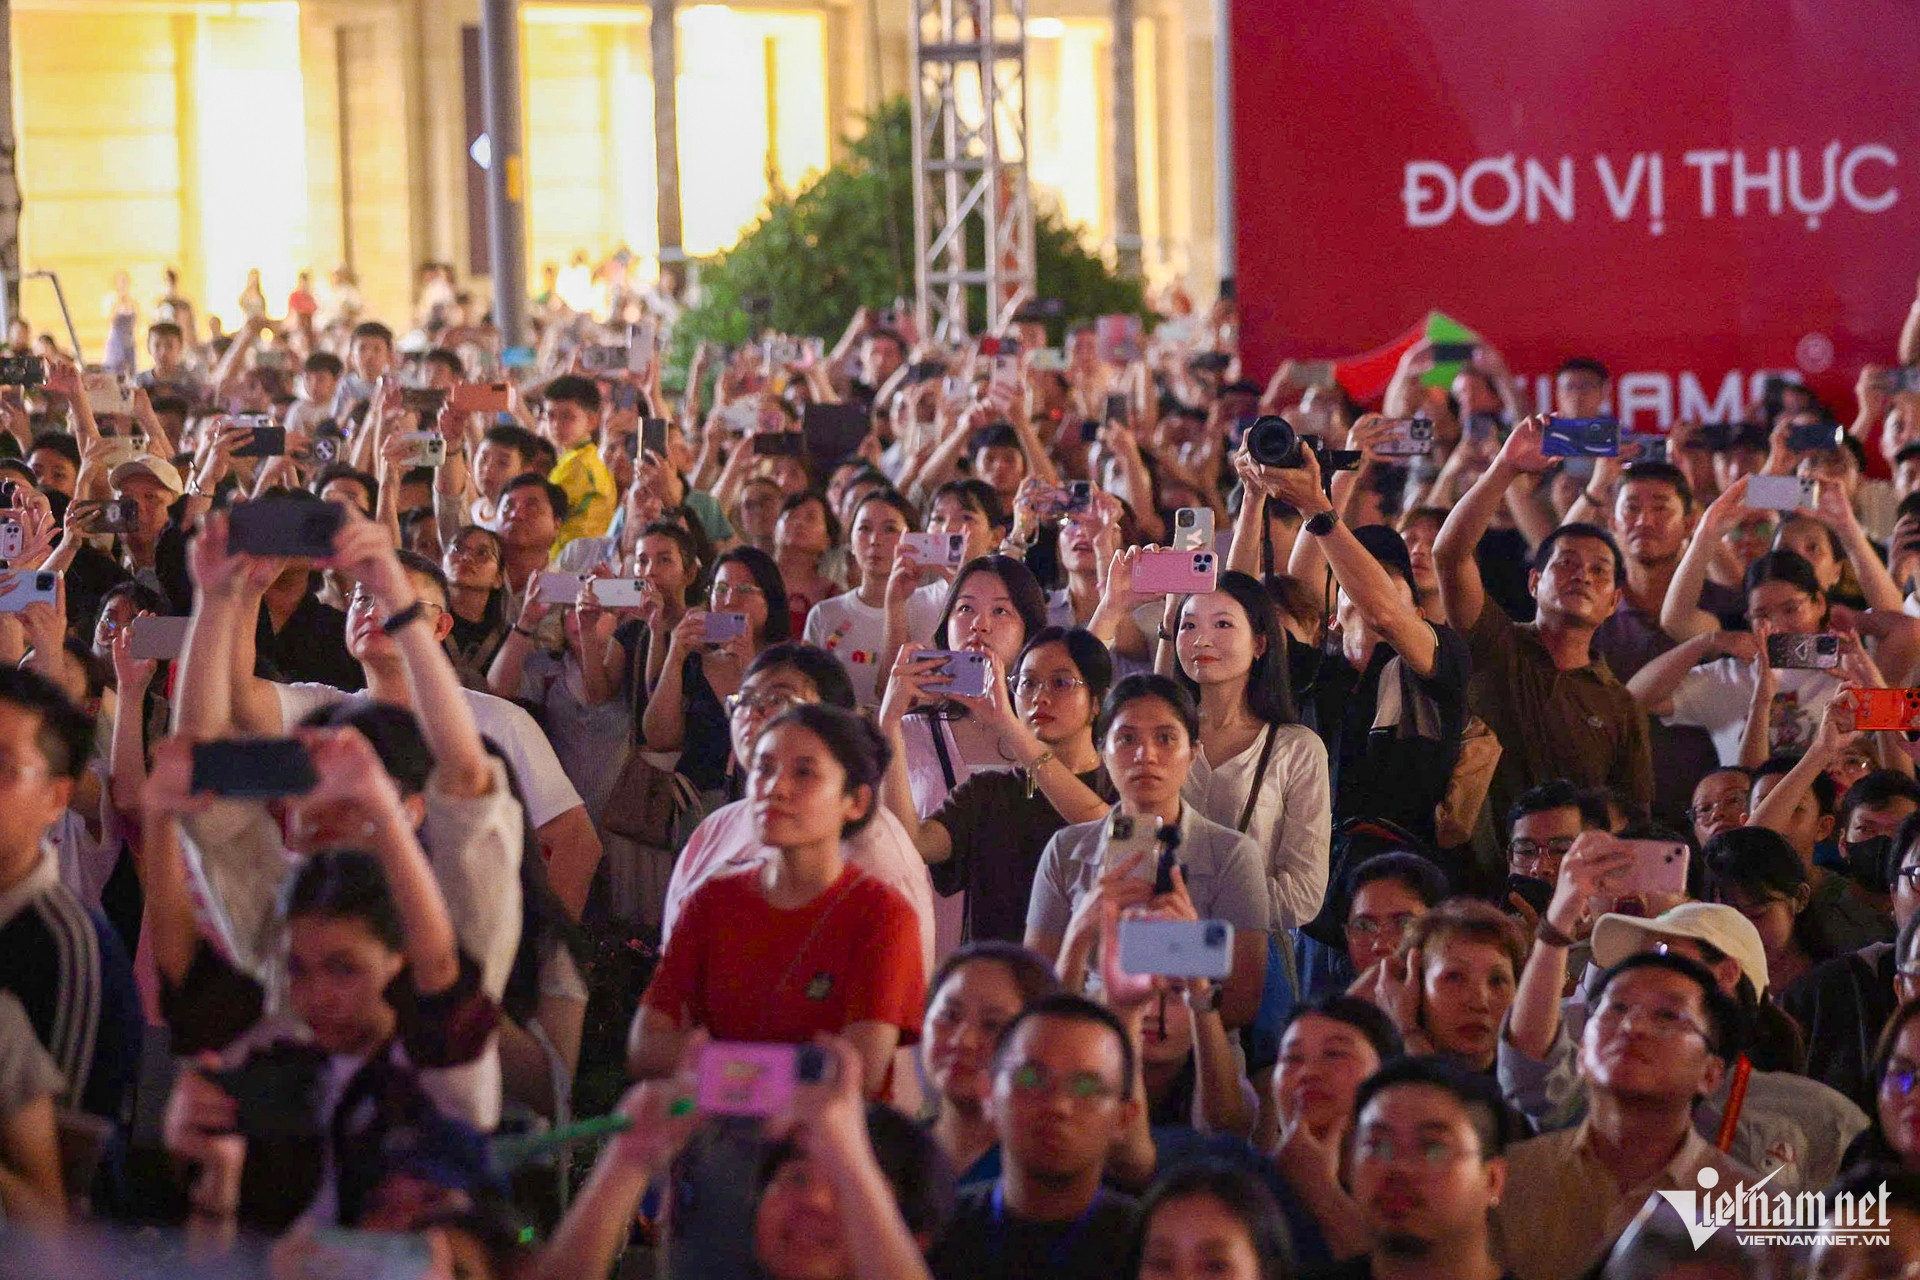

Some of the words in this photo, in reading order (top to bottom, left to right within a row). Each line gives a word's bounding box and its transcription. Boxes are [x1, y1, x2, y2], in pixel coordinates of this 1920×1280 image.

[1402, 153, 1575, 226] ĐƠN
[1596, 152, 1664, 235] VỊ
[1684, 139, 1899, 232] THỰC
